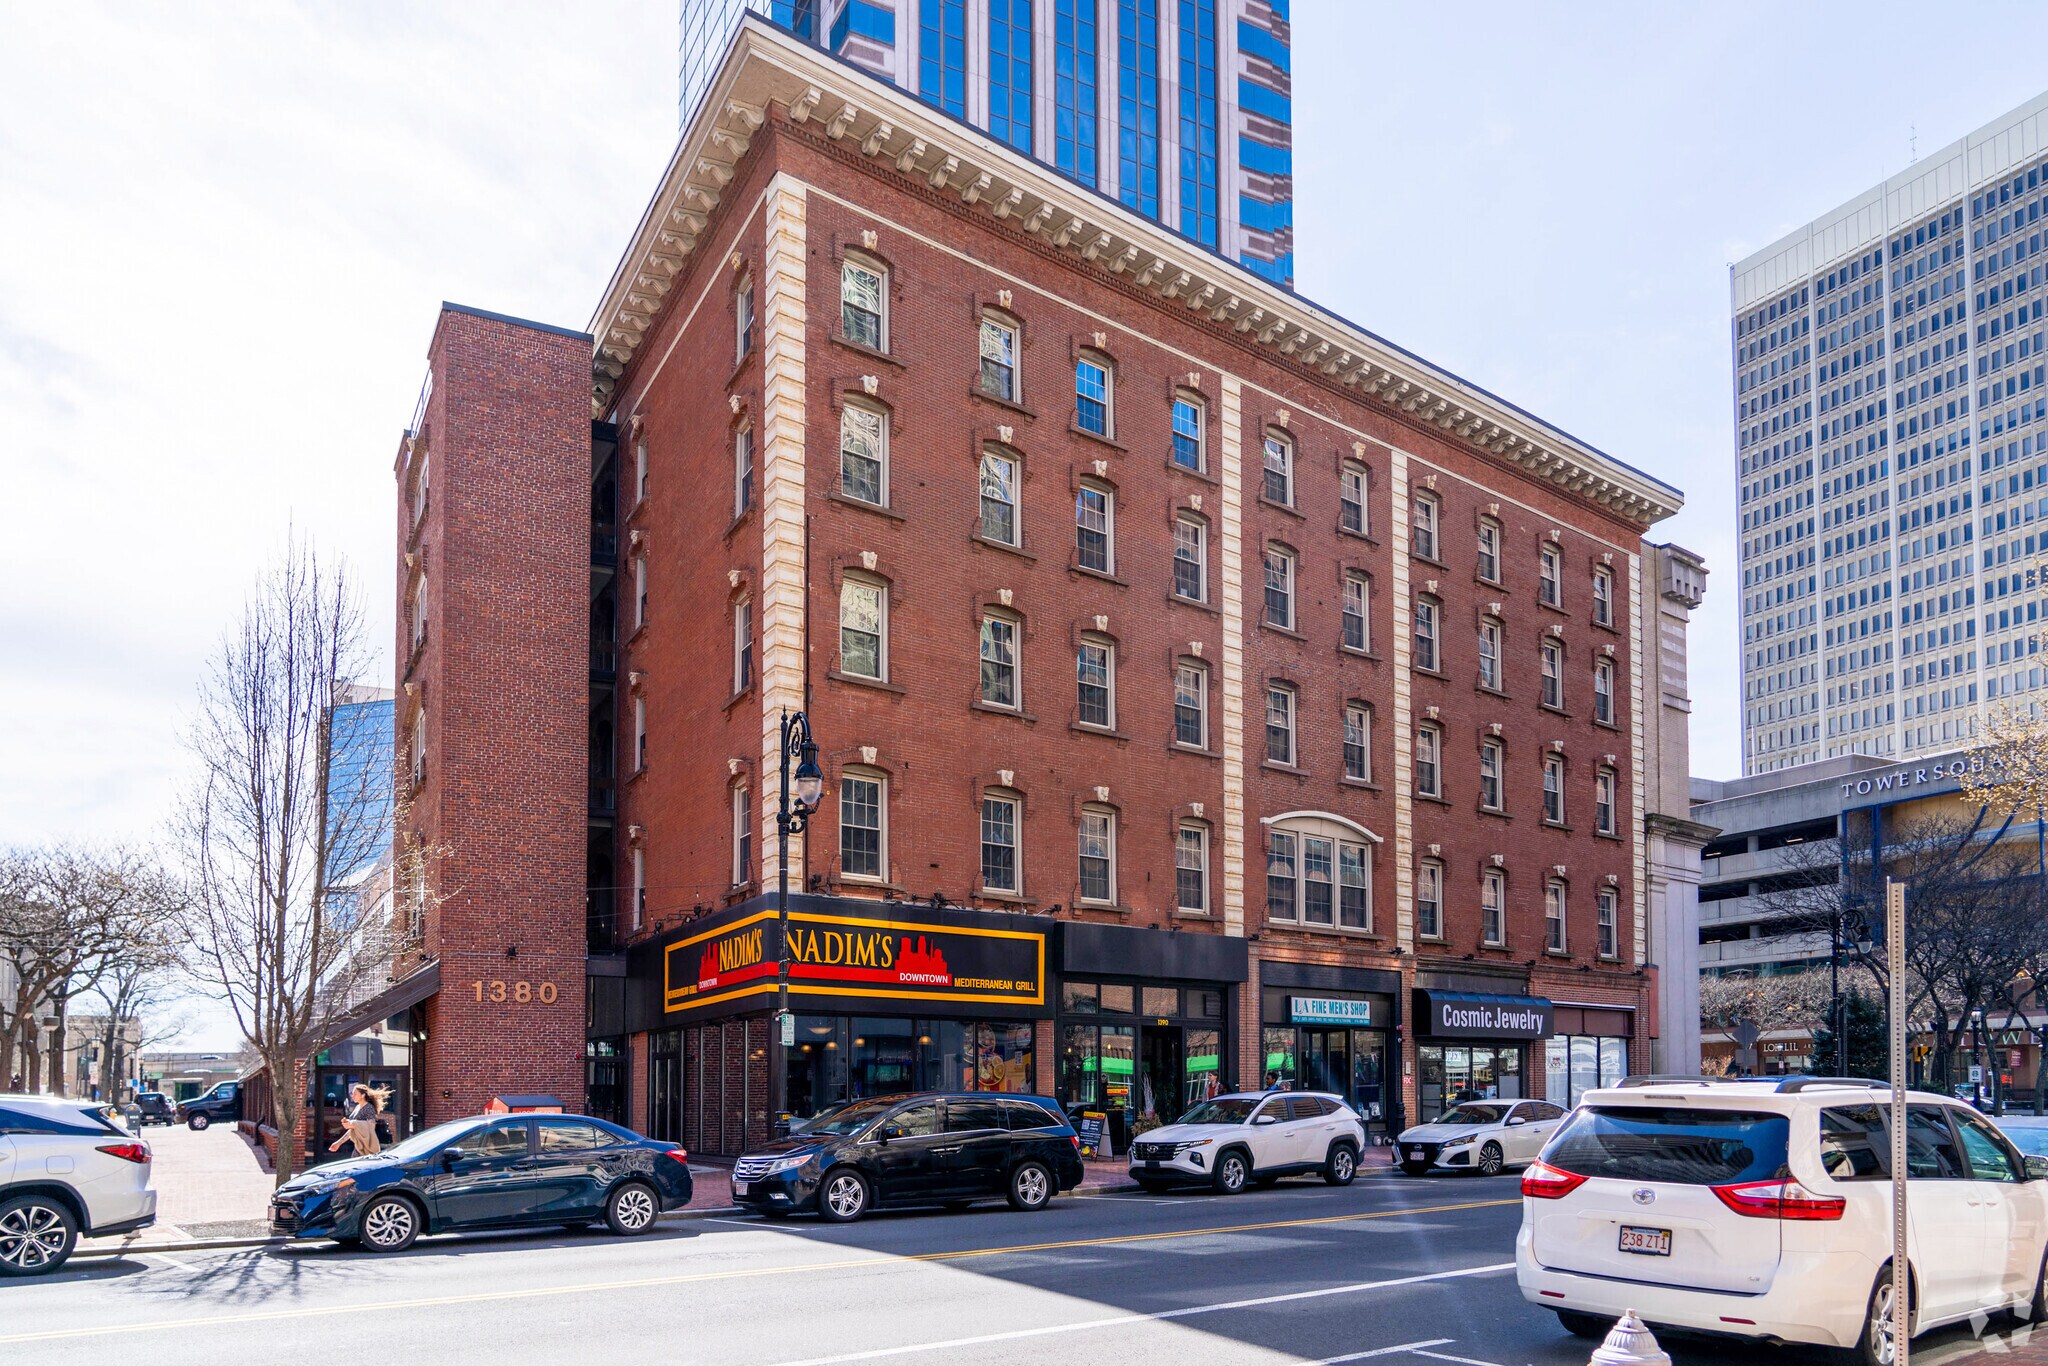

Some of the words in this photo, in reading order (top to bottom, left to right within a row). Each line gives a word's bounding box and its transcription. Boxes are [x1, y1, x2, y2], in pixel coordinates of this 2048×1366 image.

[719, 928, 762, 972] NADIM'S
[787, 929, 893, 968] NADIM'S
[900, 972, 948, 984] DOWNTOWN
[954, 977, 1013, 990] MEDITERRANEAN
[1015, 981, 1035, 991] GRILL
[471, 980, 558, 1004] 1380
[1312, 1000, 1327, 1014] FINE
[1329, 1001, 1349, 1015] MEN'S
[1351, 1002, 1367, 1016] SHOP
[1442, 1004, 1492, 1028] Cosmic
[1494, 1007, 1543, 1035] Jewelry
[1763, 1042, 1799, 1052] LOLIL
[1621, 1232, 1643, 1247] 238
[1646, 1234, 1667, 1250] ZT1
